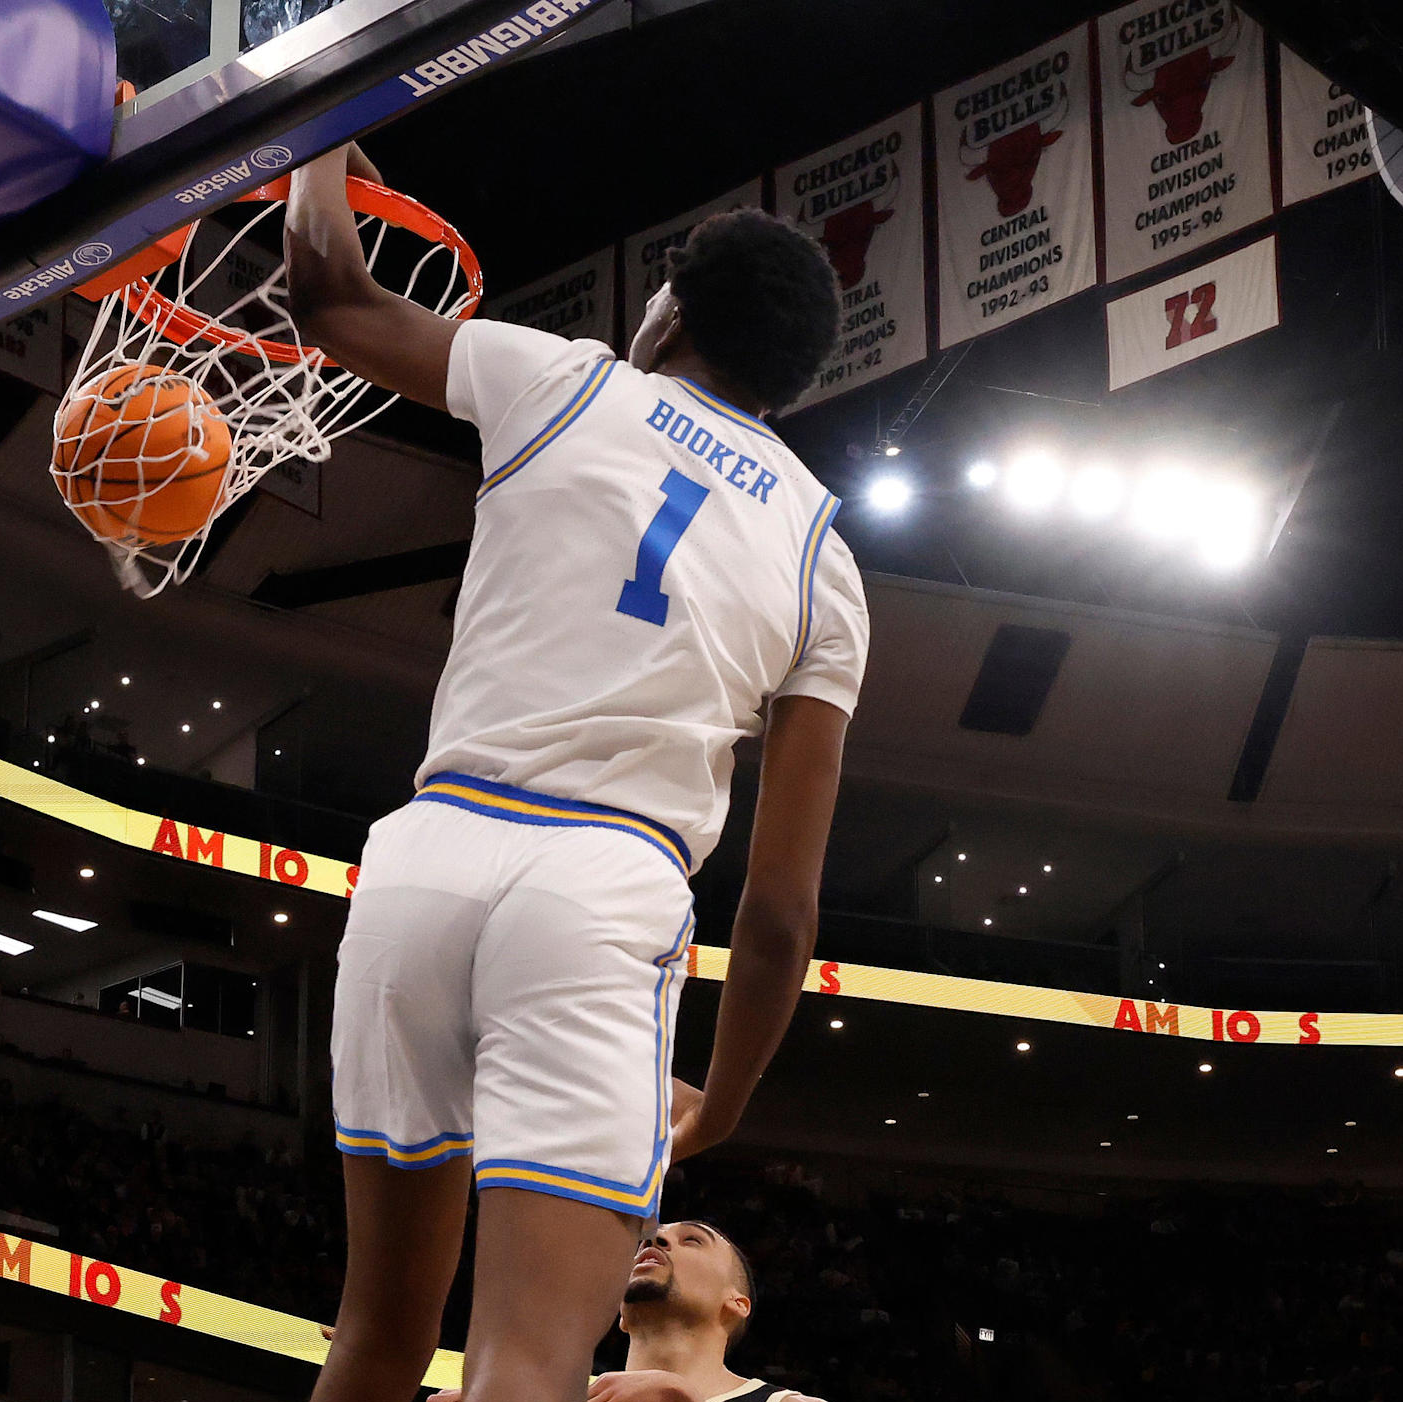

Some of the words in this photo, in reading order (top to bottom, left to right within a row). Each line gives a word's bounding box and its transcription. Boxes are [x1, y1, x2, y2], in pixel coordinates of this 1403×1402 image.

[1118, 0, 1207, 45] CHICA
[1139, 9, 1226, 68] BULLS
[954, 51, 1070, 122] CHICAGO
[974, 86, 1055, 142] BULLS
[794, 131, 901, 196] CHICAGO
[1148, 152, 1224, 201] DIVISION
[1150, 130, 1221, 174] CENTRAL
[175, 160, 251, 204] Allstate
[811, 164, 888, 218] BULLS
[1135, 173, 1236, 232] CHAMPIONS
[979, 228, 1050, 273] DIVISION
[980, 205, 1048, 247] CENTRAL
[1151, 206, 1223, 250] 1995-96
[3, 259, 76, 301] Allstate
[967, 245, 1063, 300] CHAMPIONS
[980, 275, 1049, 318] 1992-93
[1165, 280, 1219, 351] 72
[646, 398, 778, 504] BOOKER
[616, 468, 710, 627] 1
[153, 820, 225, 869] AM
[261, 843, 309, 887] IO
[821, 963, 841, 995] S
[1115, 1001, 1179, 1035] AM
[1213, 1012, 1262, 1043] IO
[1300, 1014, 1322, 1045] S
[71, 1255, 122, 1308] IO
[161, 1282, 183, 1325] S
